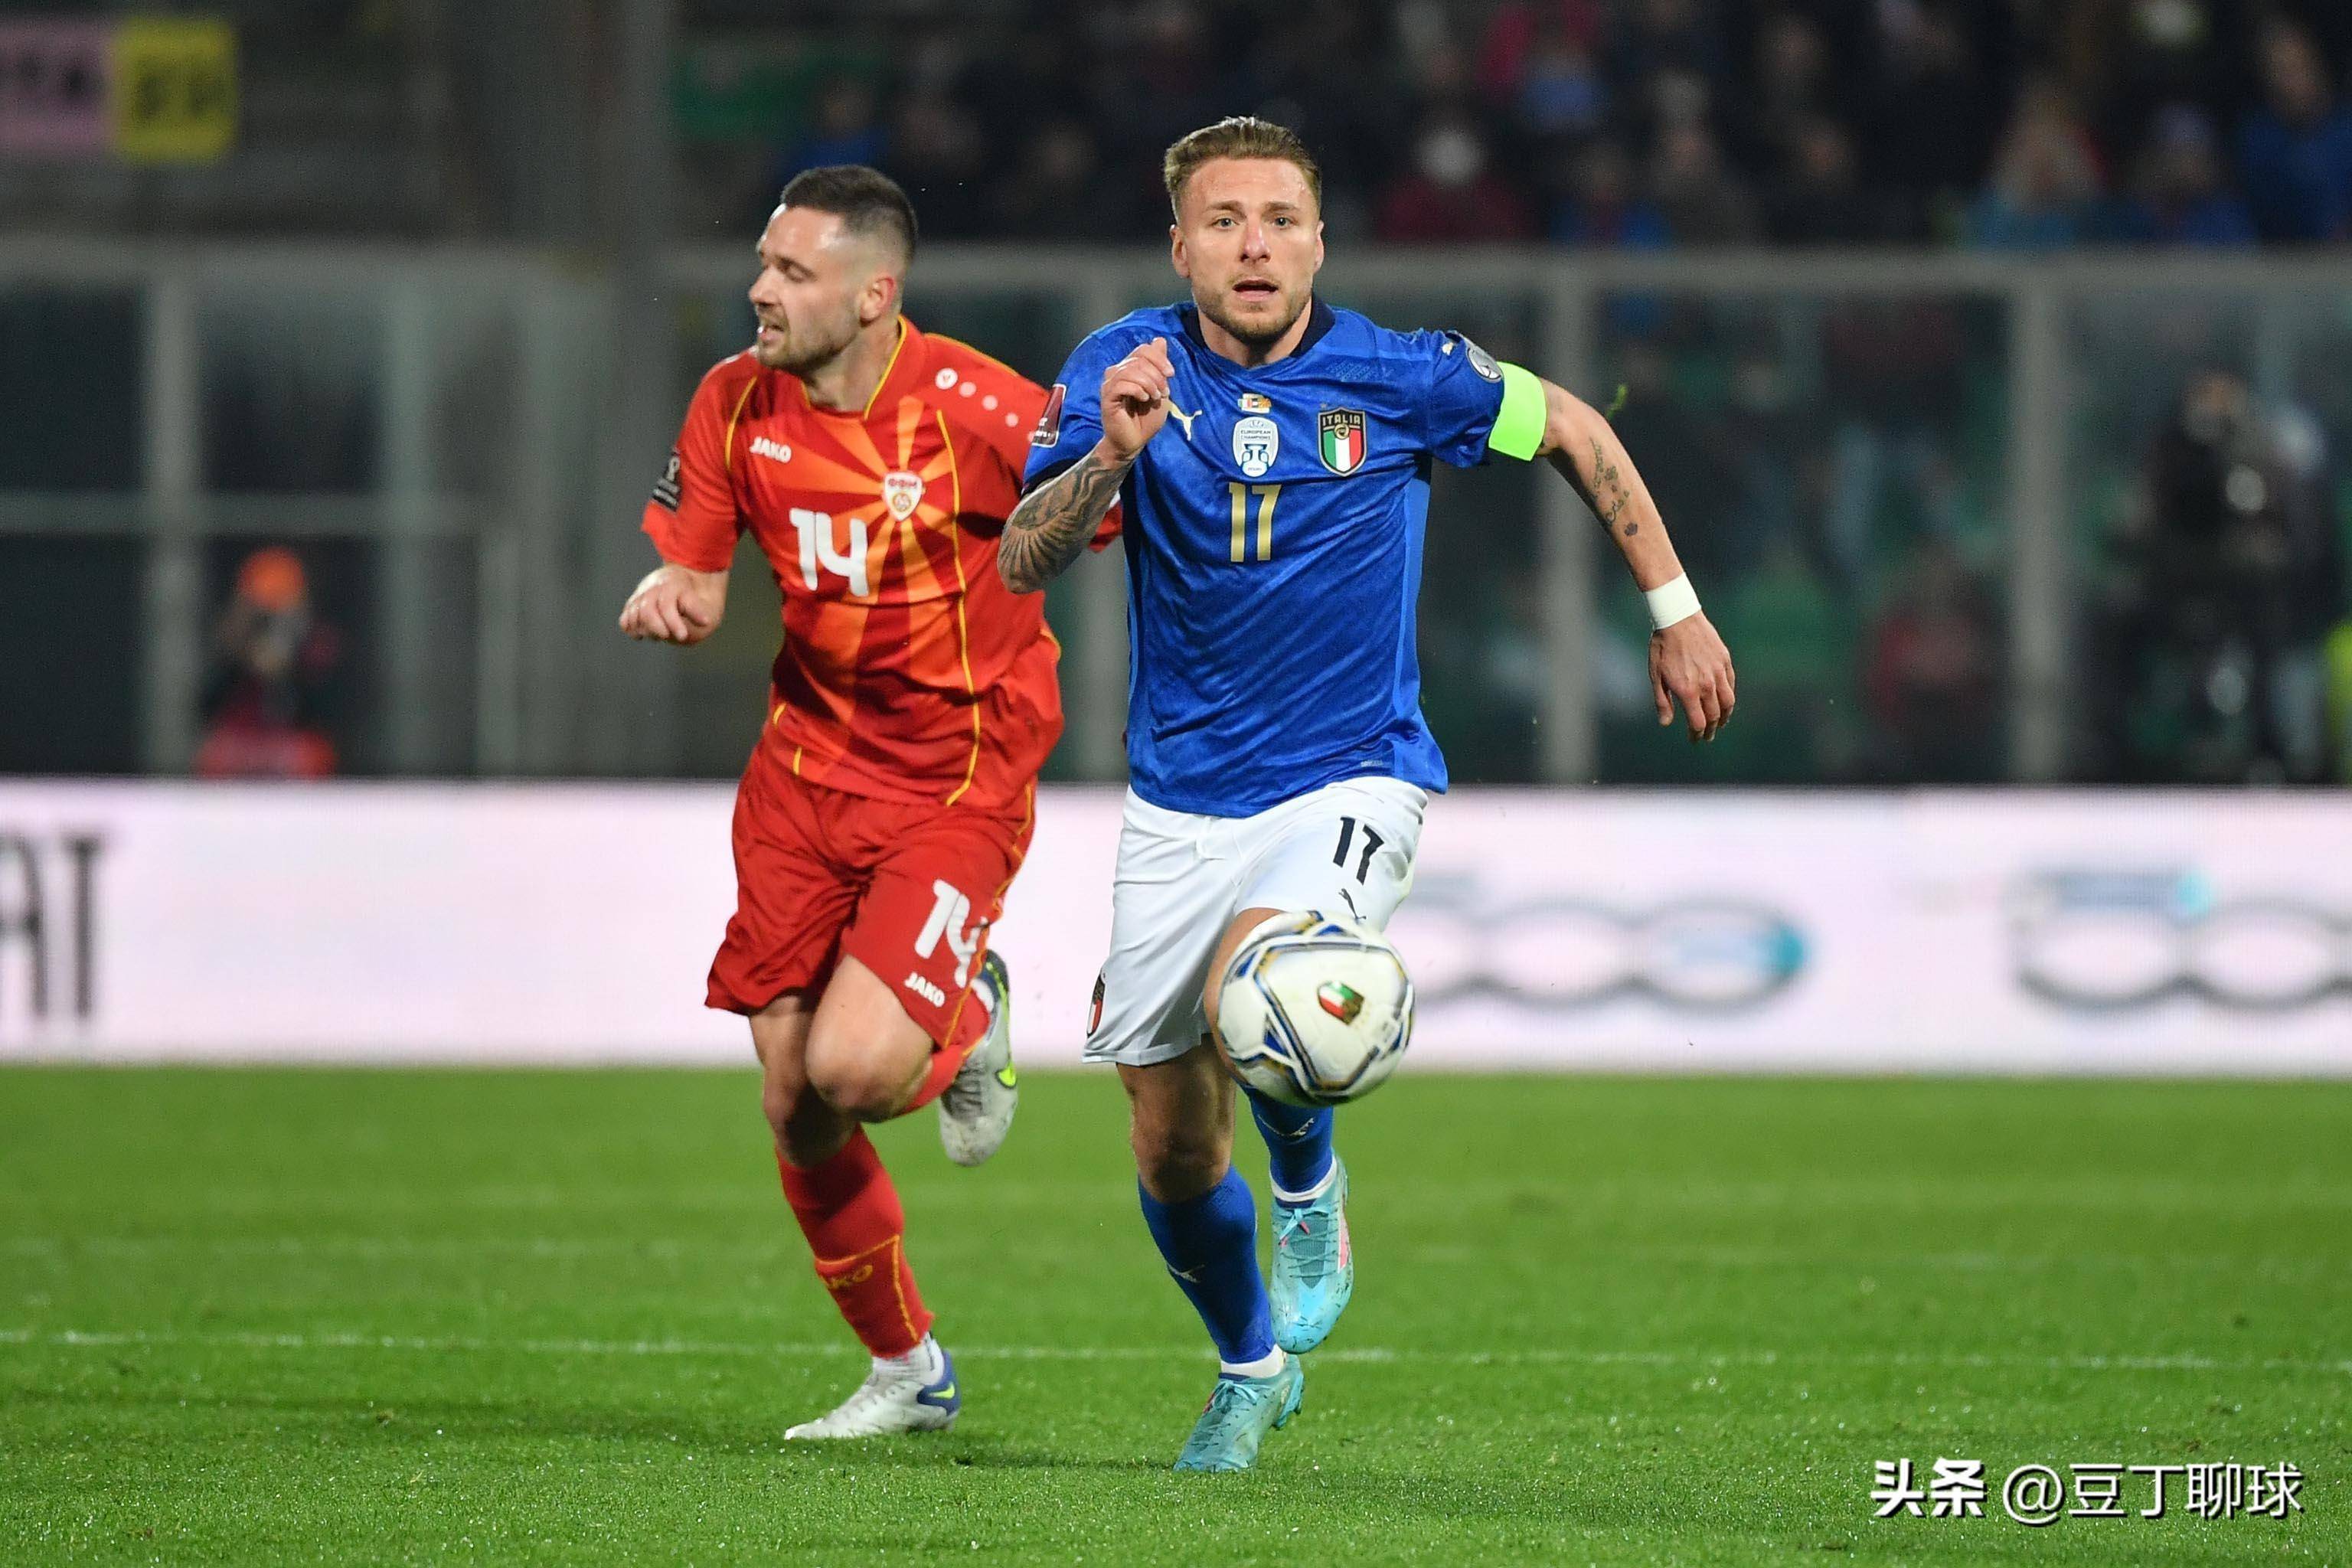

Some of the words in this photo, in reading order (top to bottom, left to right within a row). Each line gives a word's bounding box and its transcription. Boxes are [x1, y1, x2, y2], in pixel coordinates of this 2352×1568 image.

[750, 436, 792, 464] JAKO
[1322, 414, 1361, 426] ITALIA
[789, 507, 869, 597] 14
[1229, 482, 1282, 563] 17
[1333, 816, 1384, 886] 17
[914, 878, 988, 988] 14
[904, 972, 946, 1008] JAKO
